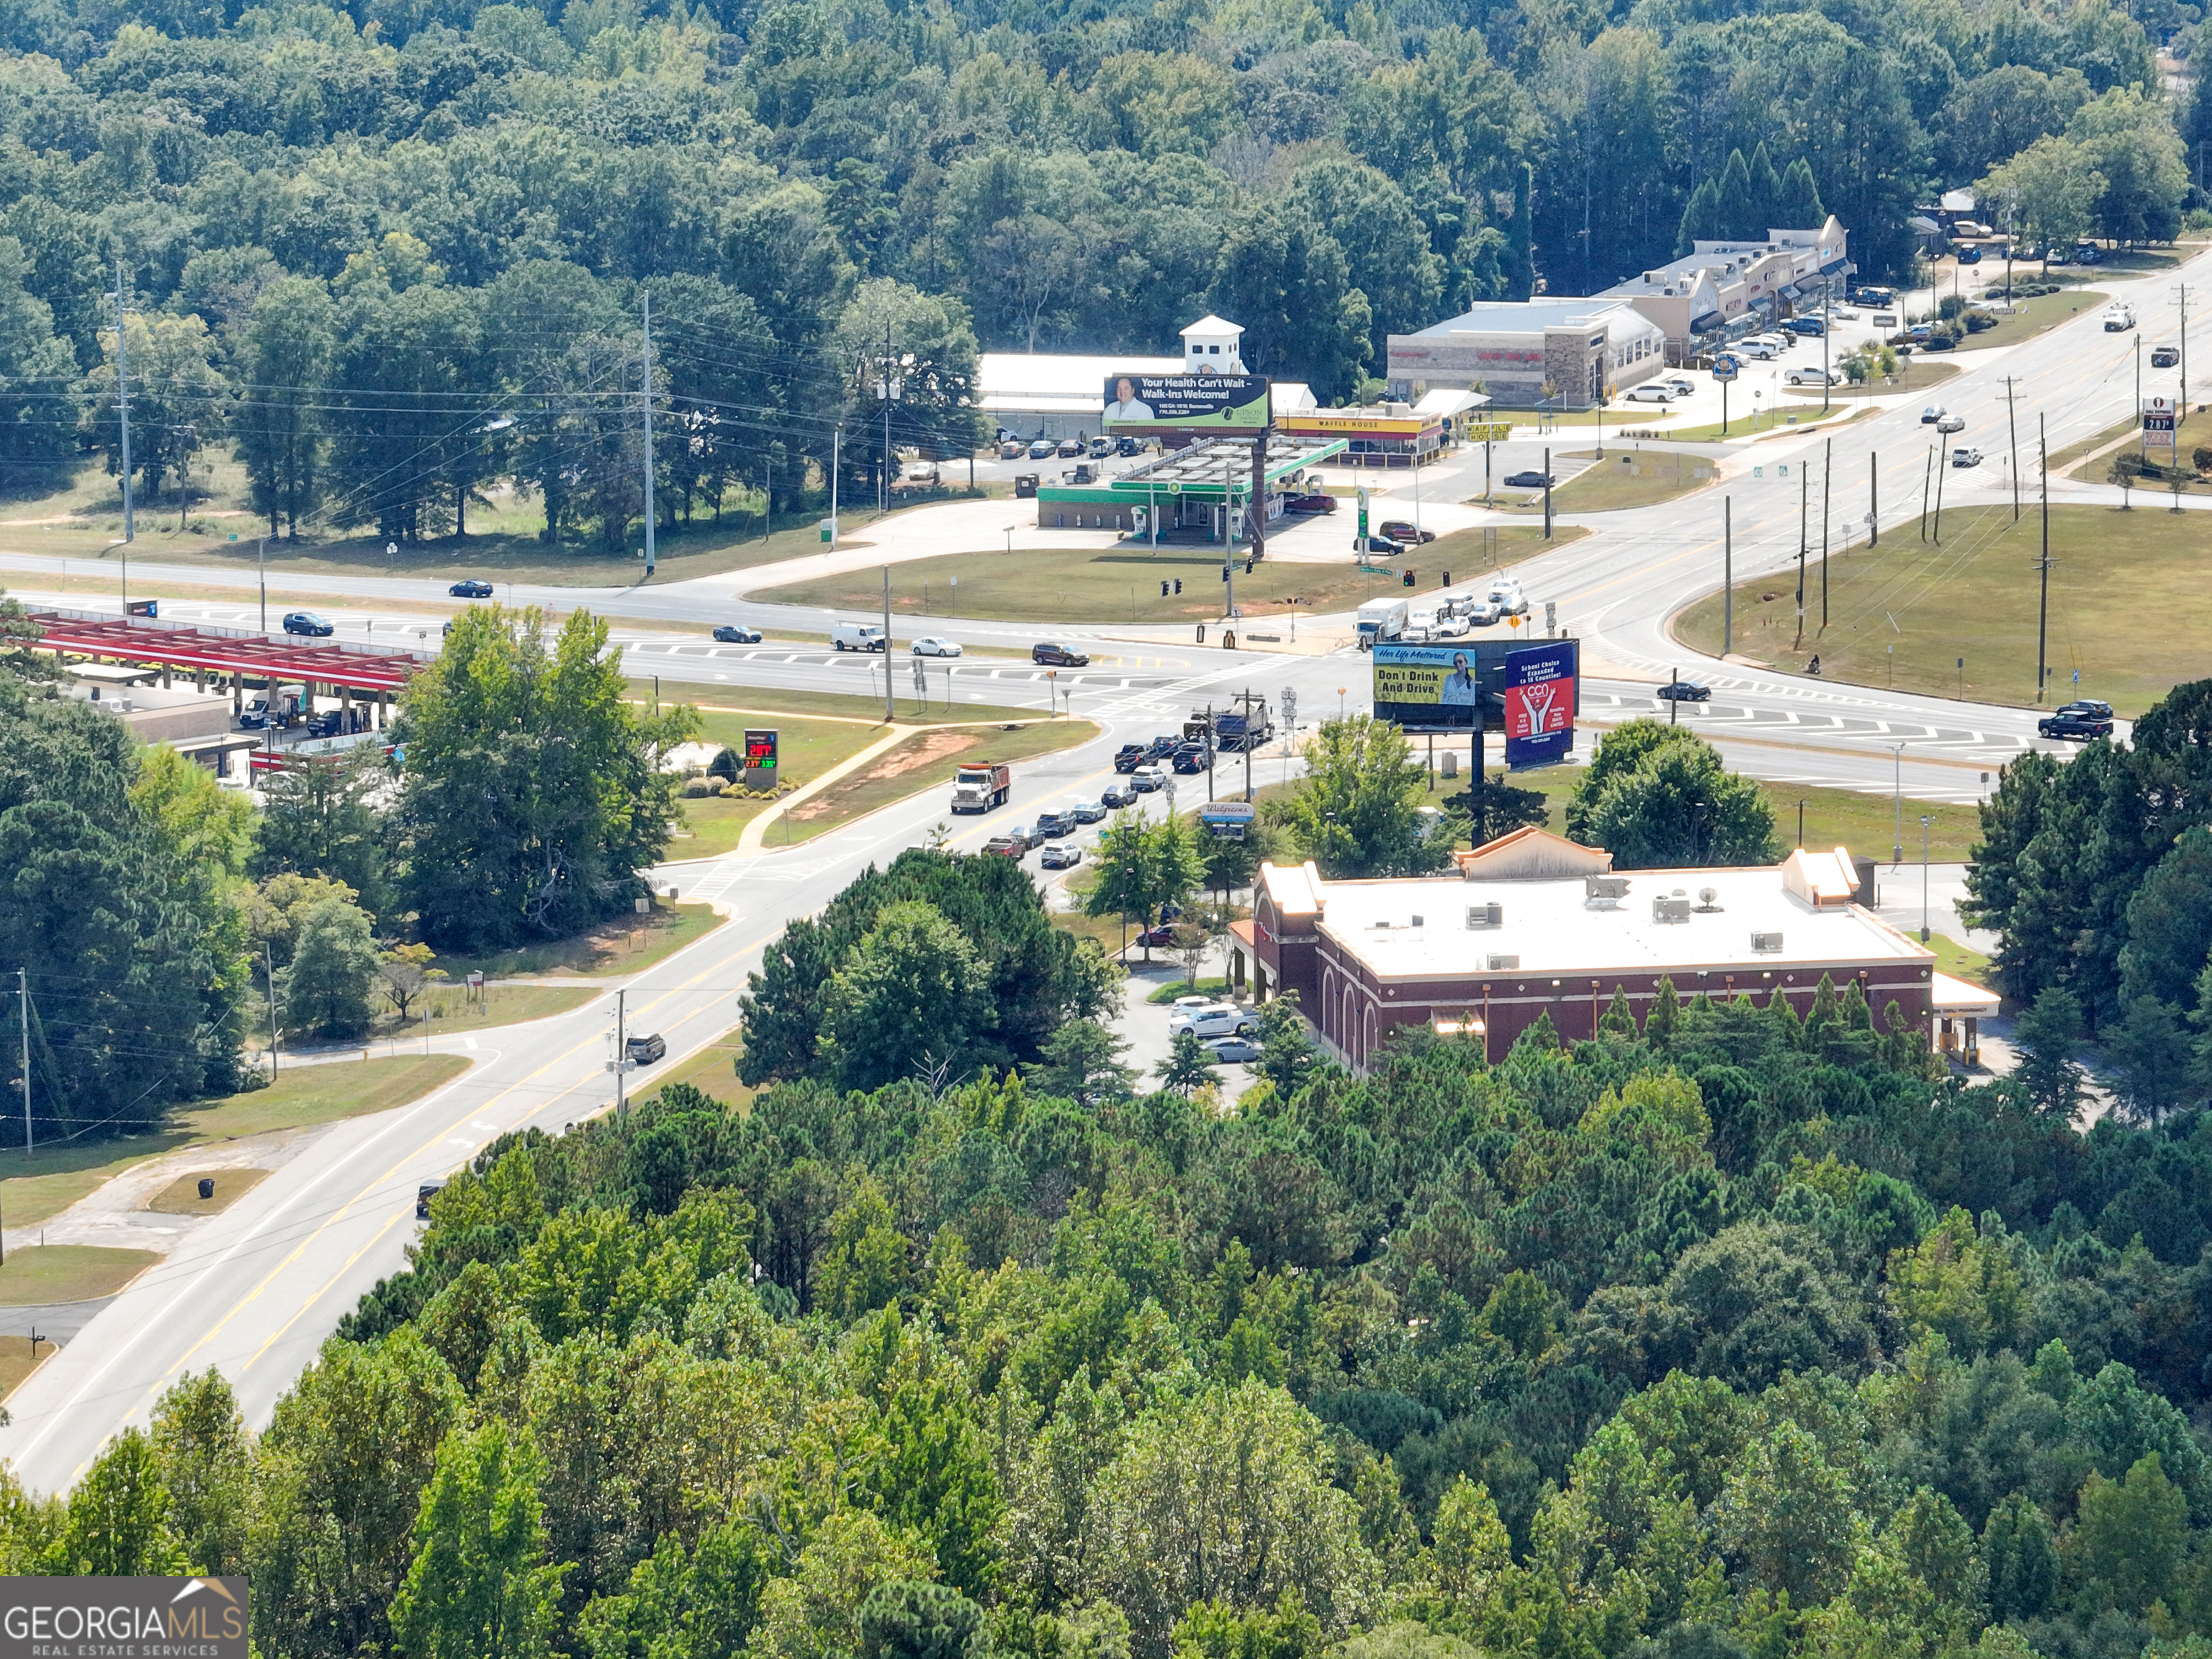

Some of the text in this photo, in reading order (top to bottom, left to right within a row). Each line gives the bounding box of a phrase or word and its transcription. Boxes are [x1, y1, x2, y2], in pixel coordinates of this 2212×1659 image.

[1141, 378, 1163, 388] Your
[1165, 378, 1196, 387] Health
[1198, 378, 1222, 388] Can't
[1223, 379, 1245, 388] Wait
[1141, 389, 1229, 399] Walk-Ins Welcome!
[1379, 649, 1447, 662] Her Life Mattered
[1521, 662, 1539, 672] School
[1527, 667, 1554, 677] Expanded
[1378, 670, 1439, 681] Don't Drink
[1382, 682, 1434, 693] And Drive
[1207, 804, 1248, 814] Walgreens
